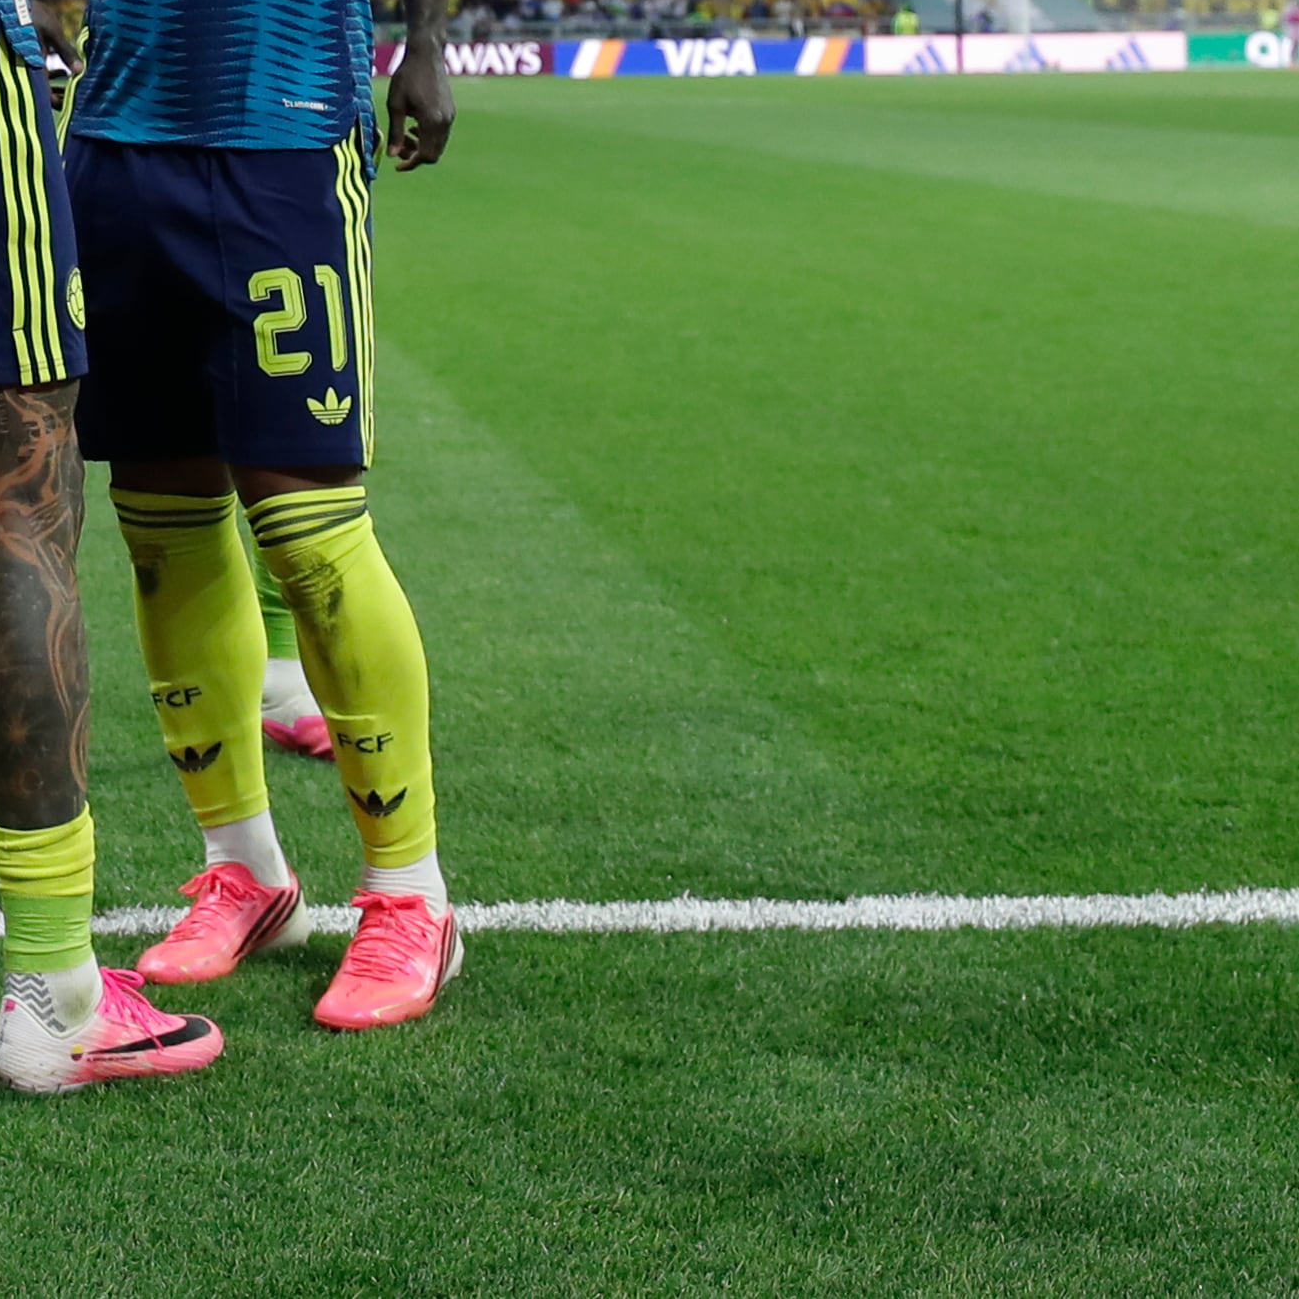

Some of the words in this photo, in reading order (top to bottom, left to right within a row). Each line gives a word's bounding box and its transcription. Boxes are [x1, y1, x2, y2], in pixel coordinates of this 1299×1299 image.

[655, 38, 757, 77] VISA
[248, 264, 348, 377] 21
[152, 687, 202, 709] FCF
[337, 732, 393, 753] FCF
